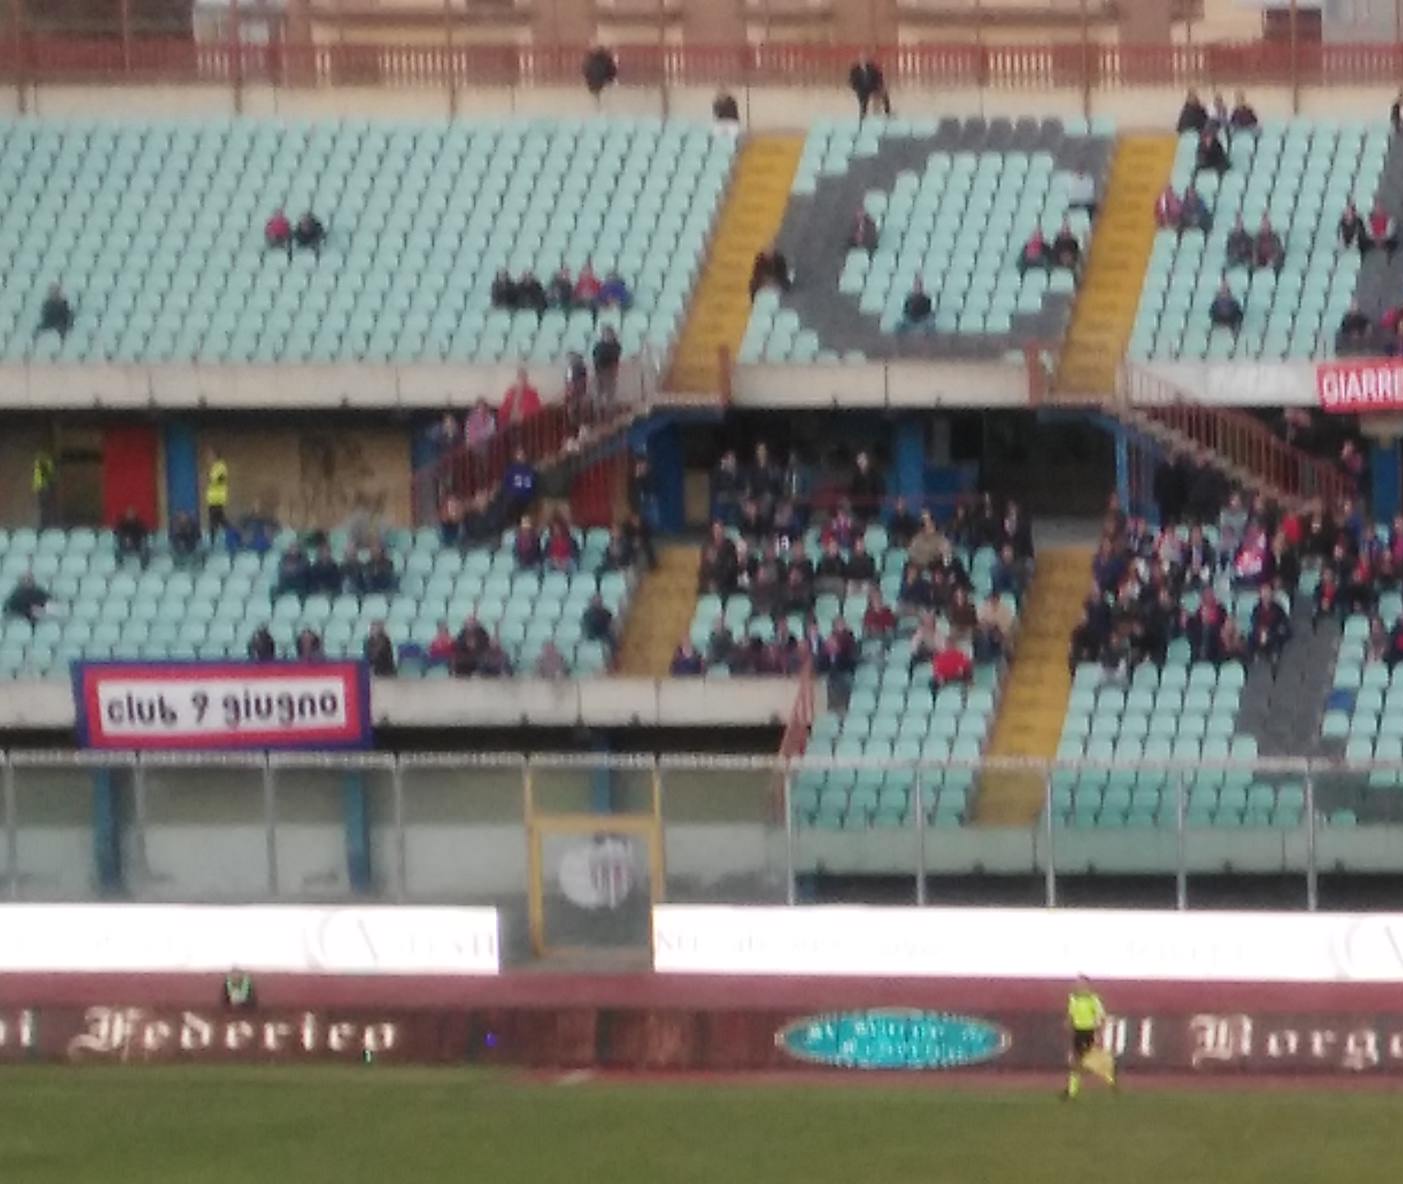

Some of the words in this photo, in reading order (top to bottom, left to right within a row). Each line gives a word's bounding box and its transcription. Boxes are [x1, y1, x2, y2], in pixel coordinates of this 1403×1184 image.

[107, 690, 178, 726] club
[191, 689, 209, 725] 9
[222, 688, 339, 730] giugno
[67, 1005, 396, 1061] Federico
